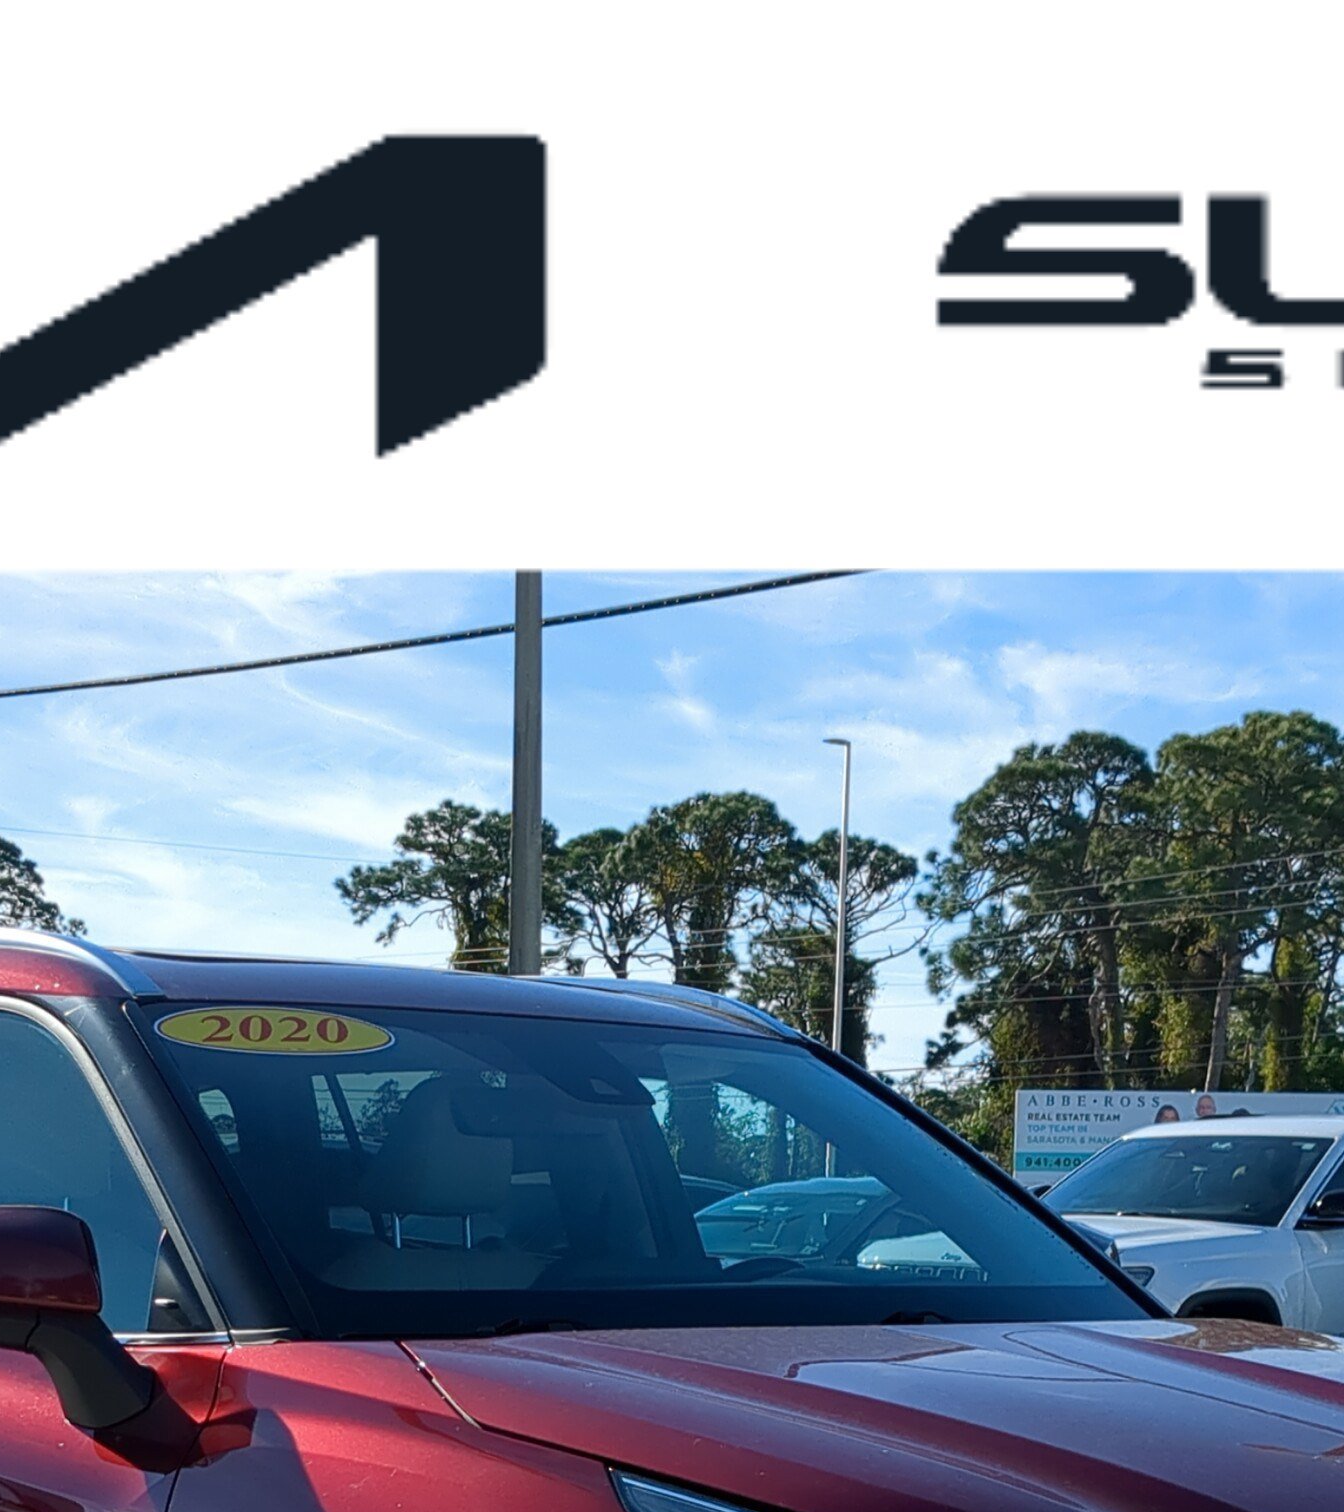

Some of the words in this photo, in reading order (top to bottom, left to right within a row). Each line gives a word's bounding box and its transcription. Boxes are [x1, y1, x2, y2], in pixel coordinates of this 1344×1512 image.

[201, 1014, 349, 1043] 2020
[1027, 1112, 1053, 1121] REAL
[1056, 1112, 1091, 1122] ESTATE
[1093, 1113, 1121, 1122] TEAM
[1027, 1123, 1046, 1132] TOP
[1049, 1124, 1075, 1133] TEAM
[1027, 1135, 1076, 1144] SARASOTA
